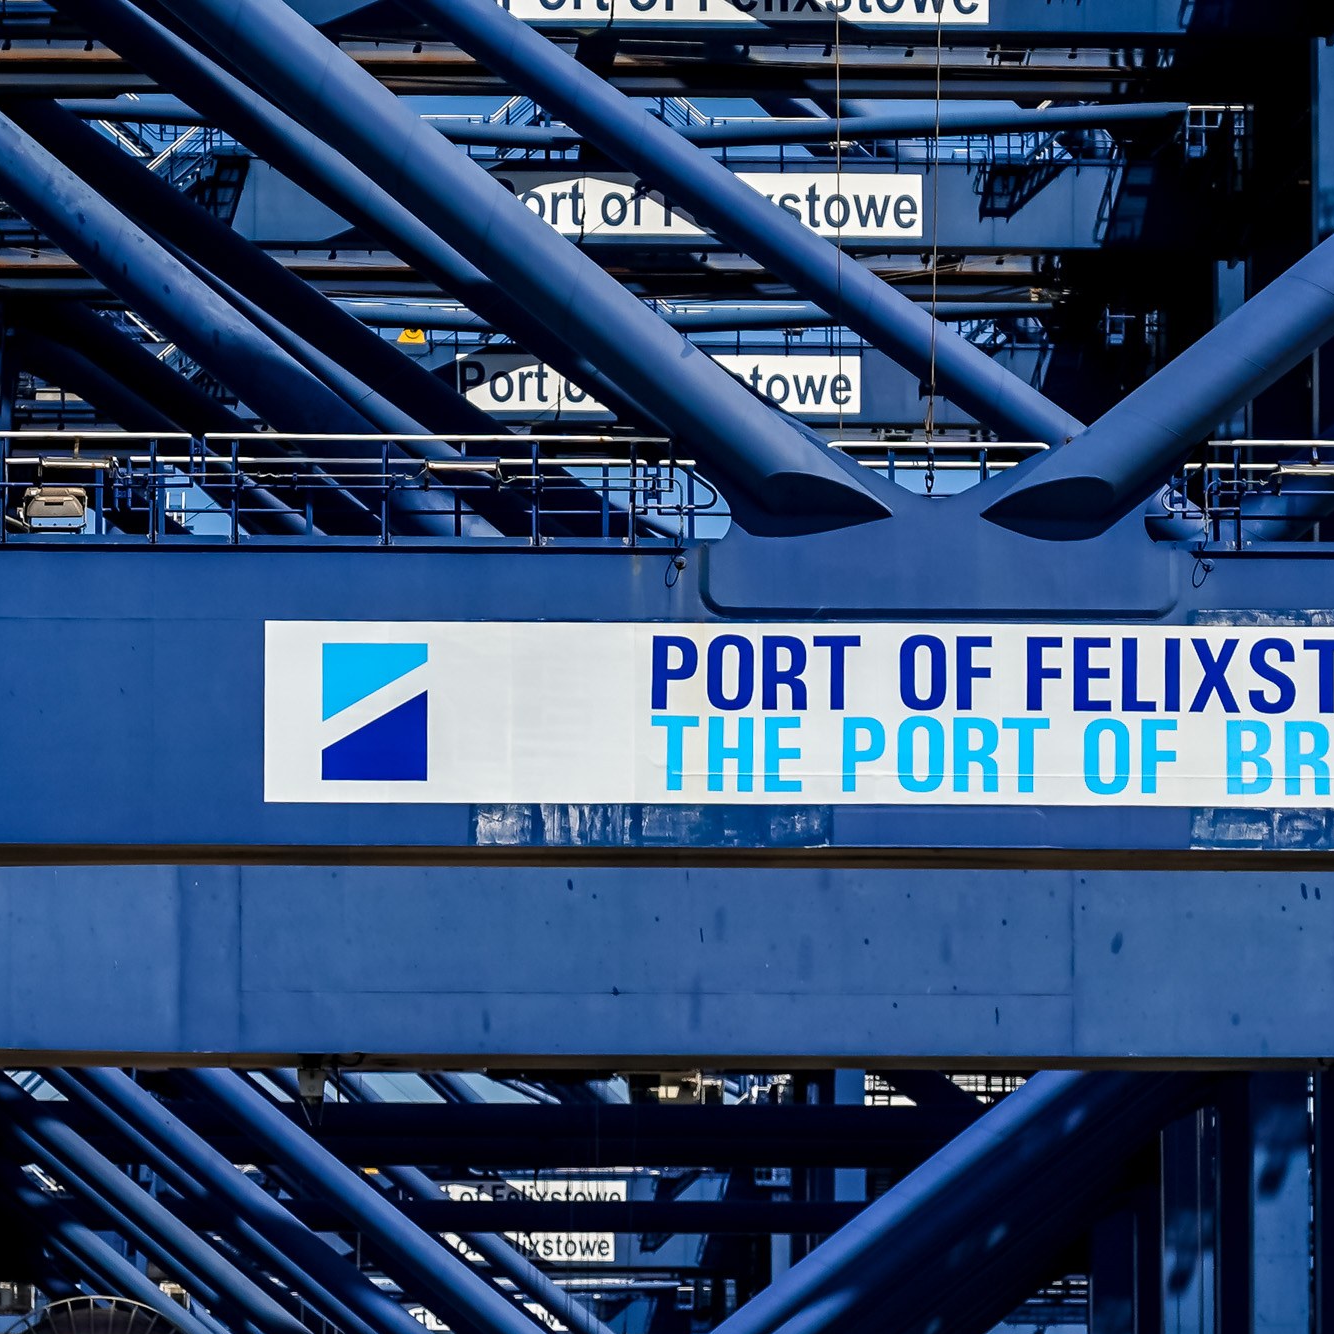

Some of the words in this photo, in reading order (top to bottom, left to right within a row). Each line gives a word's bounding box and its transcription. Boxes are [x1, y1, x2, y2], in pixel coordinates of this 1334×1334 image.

[459, 361, 548, 403] Port
[651, 634, 861, 711] PORT
[899, 634, 992, 711] OF
[651, 715, 803, 792] THE
[842, 715, 1050, 793] PORT
[1083, 717, 1177, 795] OF
